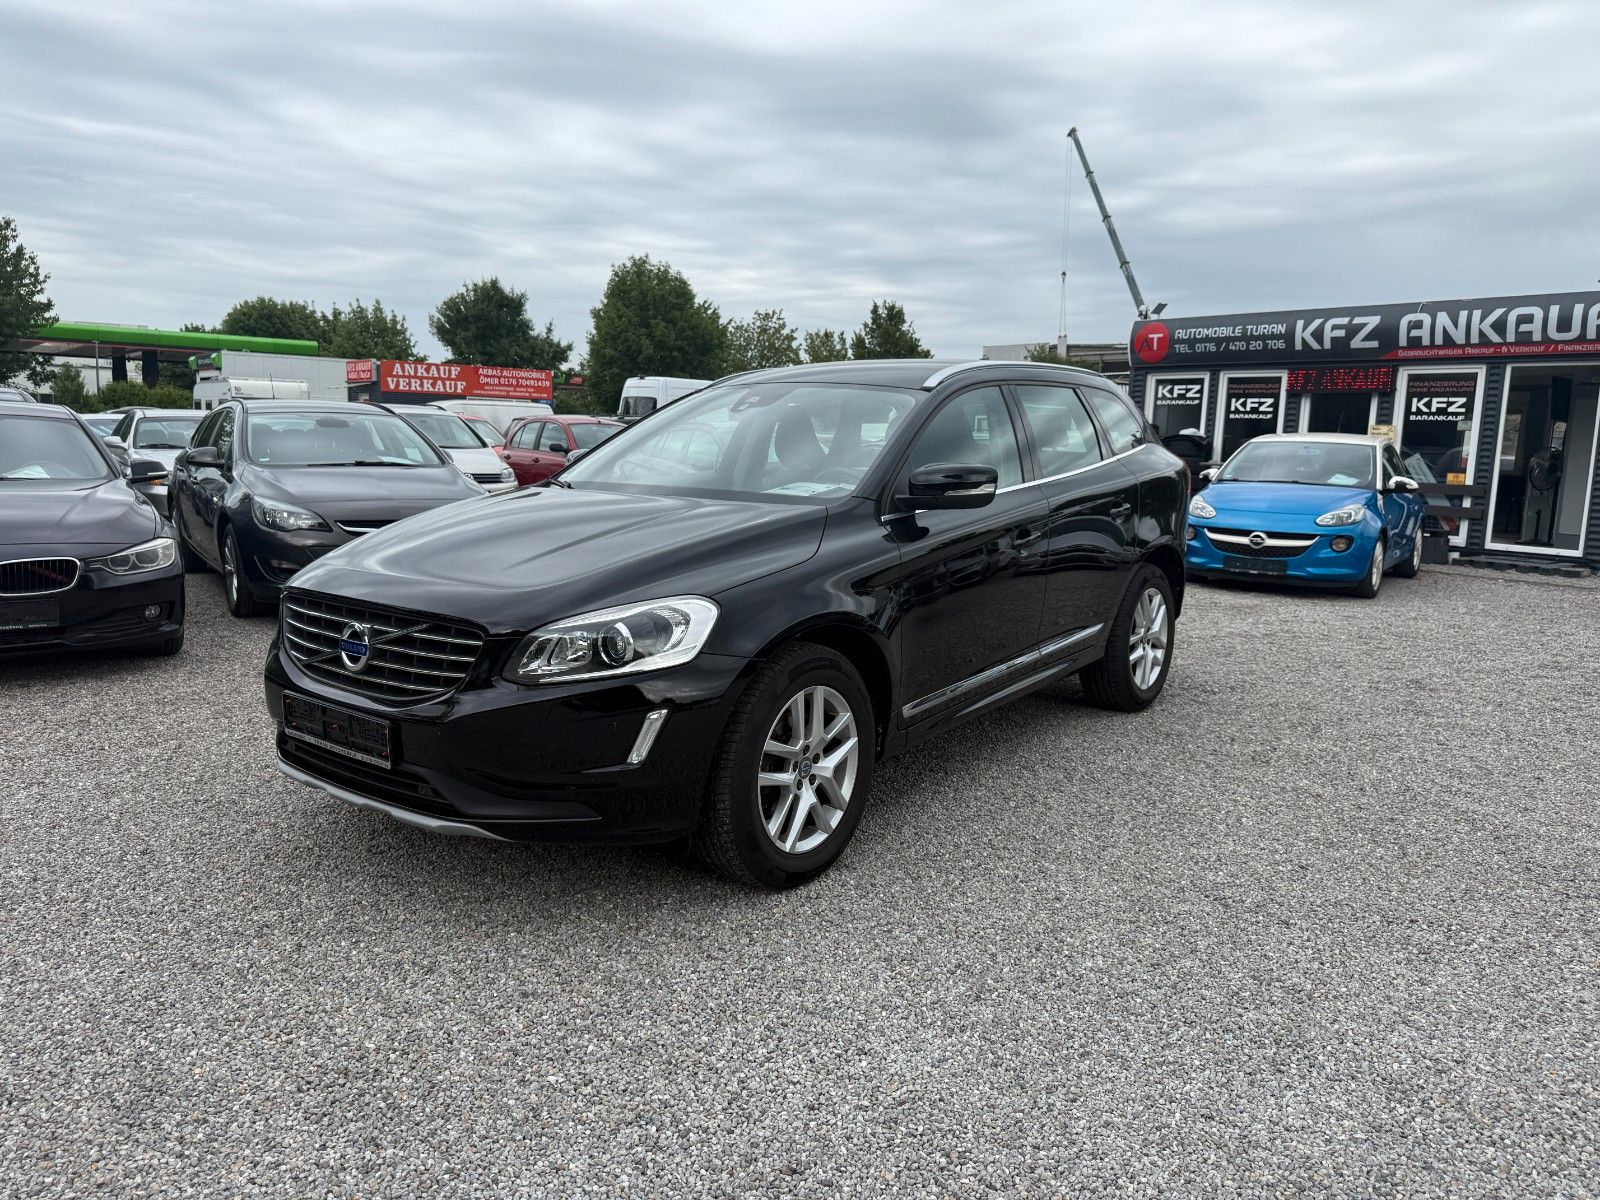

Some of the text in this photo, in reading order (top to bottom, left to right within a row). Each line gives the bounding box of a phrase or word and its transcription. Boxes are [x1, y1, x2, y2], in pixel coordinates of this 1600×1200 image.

[1174, 323, 1287, 340] AUTOMOBILE TURAN
[1294, 315, 1382, 350] KFZ
[1195, 342, 1217, 352] 0176
[1229, 341, 1246, 351] 470
[1249, 341, 1264, 350] 20
[1267, 339, 1286, 349] 706
[1509, 344, 1546, 353] VERKAUF
[393, 363, 461, 378] ANKAUF
[502, 370, 546, 379] AUTOMOBILE
[387, 378, 466, 394] VERKAUF
[479, 376, 550, 388] ÖMER 0176 70491439
[1157, 384, 1201, 398] KFZ
[1230, 398, 1275, 412] KFZ
[1411, 397, 1467, 413] KFZ
[341, 641, 366, 653] VOLVO
